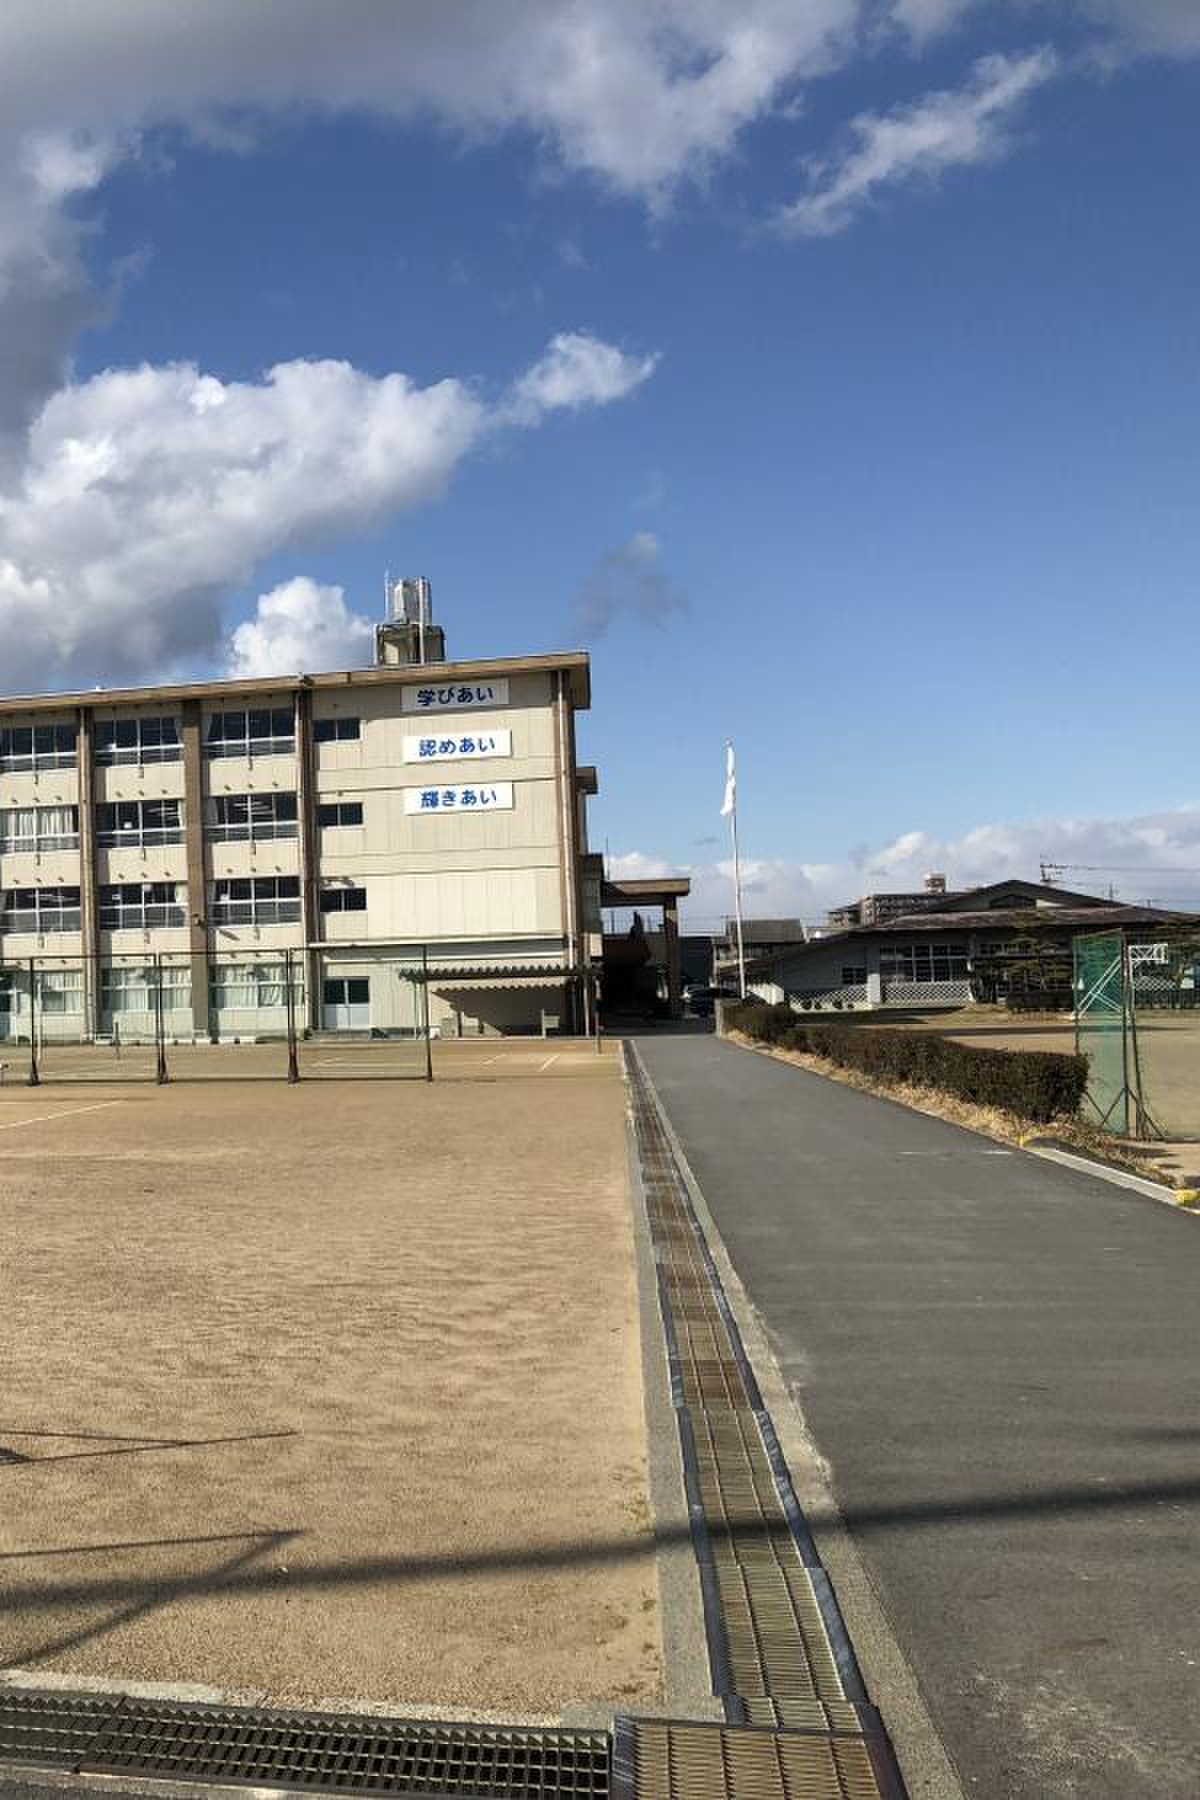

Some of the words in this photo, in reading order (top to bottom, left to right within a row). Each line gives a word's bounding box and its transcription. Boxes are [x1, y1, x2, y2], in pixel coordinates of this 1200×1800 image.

[417, 687, 494, 707] 学びあい
[419, 737, 496, 757] 認めあい
[420, 789, 497, 809] 輝きあい
